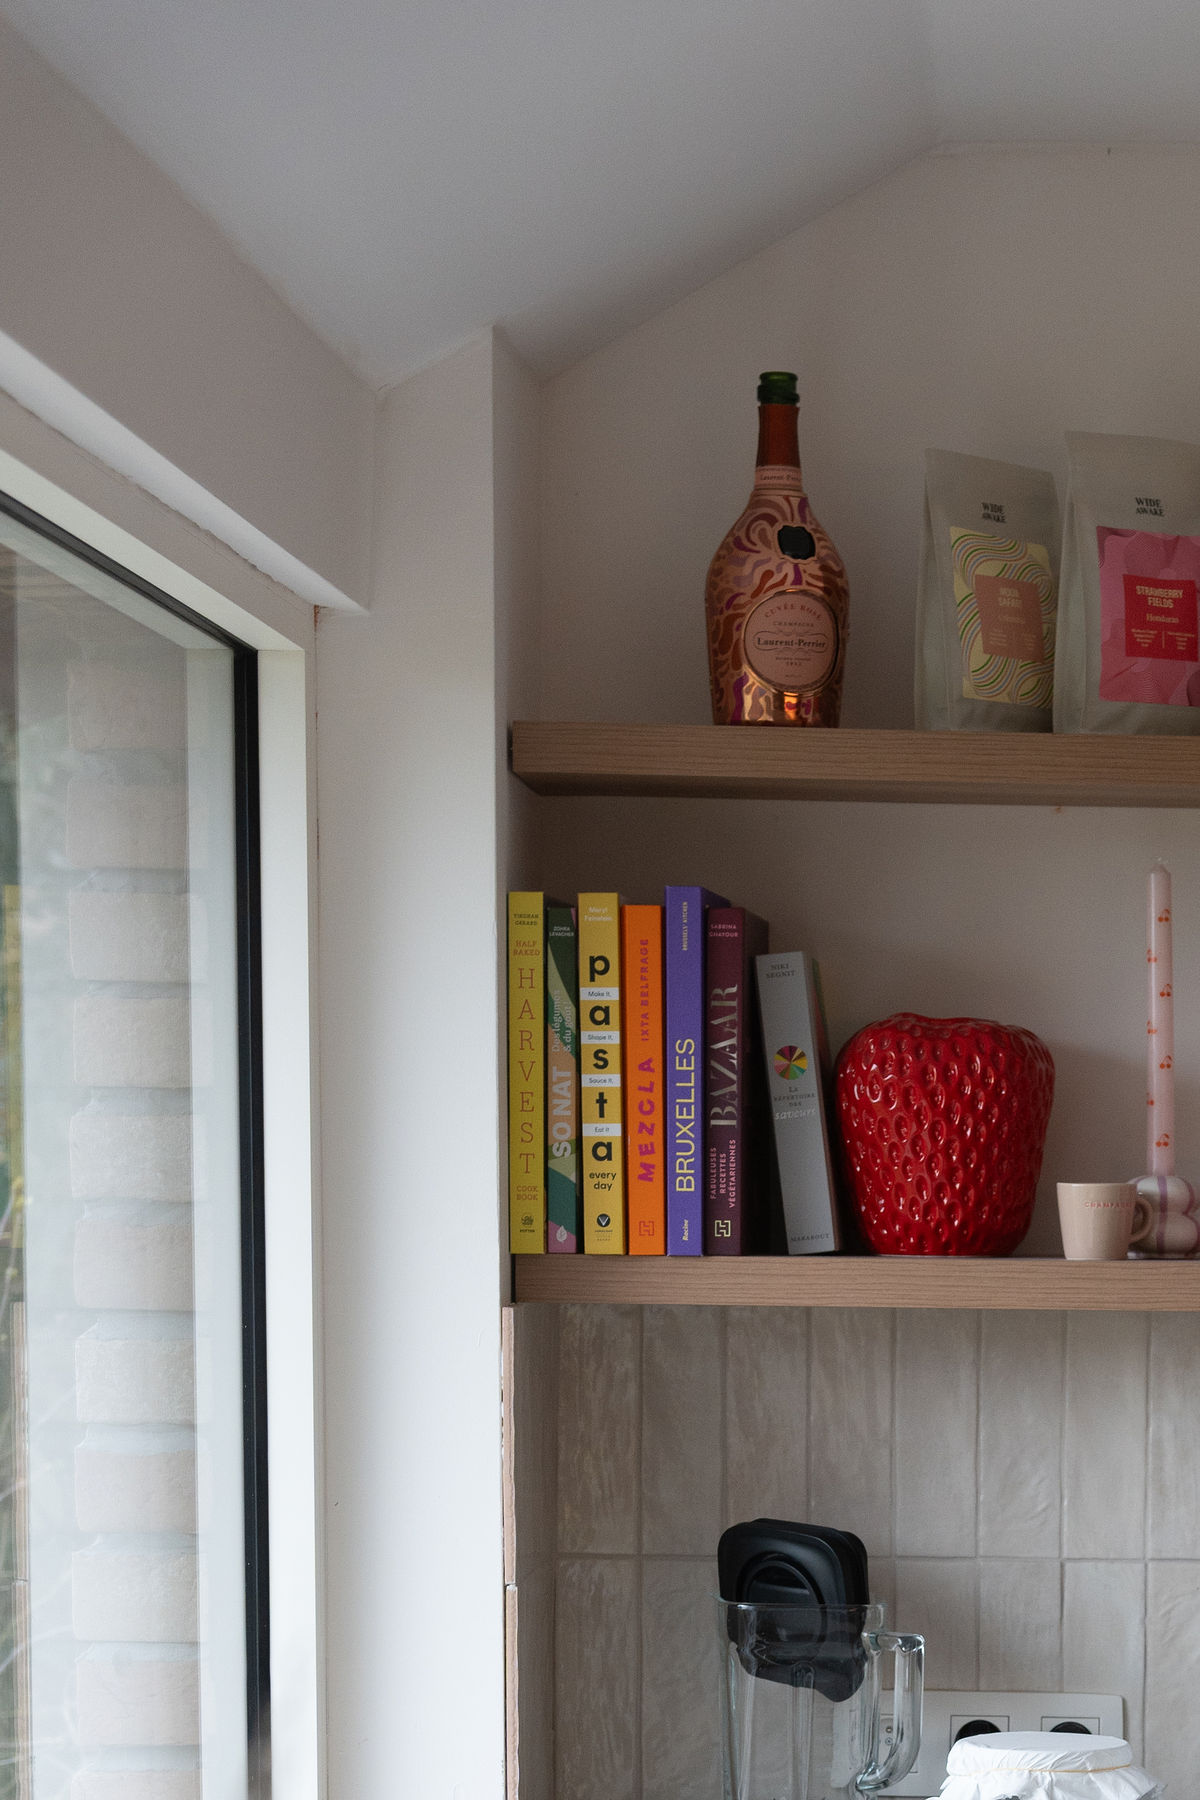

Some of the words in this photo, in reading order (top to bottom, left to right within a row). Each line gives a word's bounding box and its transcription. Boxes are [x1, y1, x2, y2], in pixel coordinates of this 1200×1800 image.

[981, 502, 1004, 513] WIDE
[1135, 497, 1163, 508] WIDE
[1136, 507, 1165, 517] AWAKE
[1136, 585, 1184, 599] STRAWBERRY
[1148, 597, 1174, 608] FIELDS
[1146, 613, 1180, 624] Honduras
[757, 637, 827, 648] Laurent-Perrier
[515, 940, 538, 948] HALF
[512, 949, 541, 957] BAKED
[640, 939, 649, 1006] BELFRAGE
[640, 1012, 649, 1042] IXTA
[588, 1034, 606, 1042] Shape
[710, 983, 738, 1128] BAZAAR
[517, 967, 537, 1174] HARVEST
[552, 1066, 572, 1116] NAT
[637, 1057, 656, 1182] MEZCLA
[675, 1038, 695, 1192] BRUXELLES
[552, 1121, 572, 1158] SO
[589, 1171, 617, 1180] every
[594, 1181, 613, 1191] day
